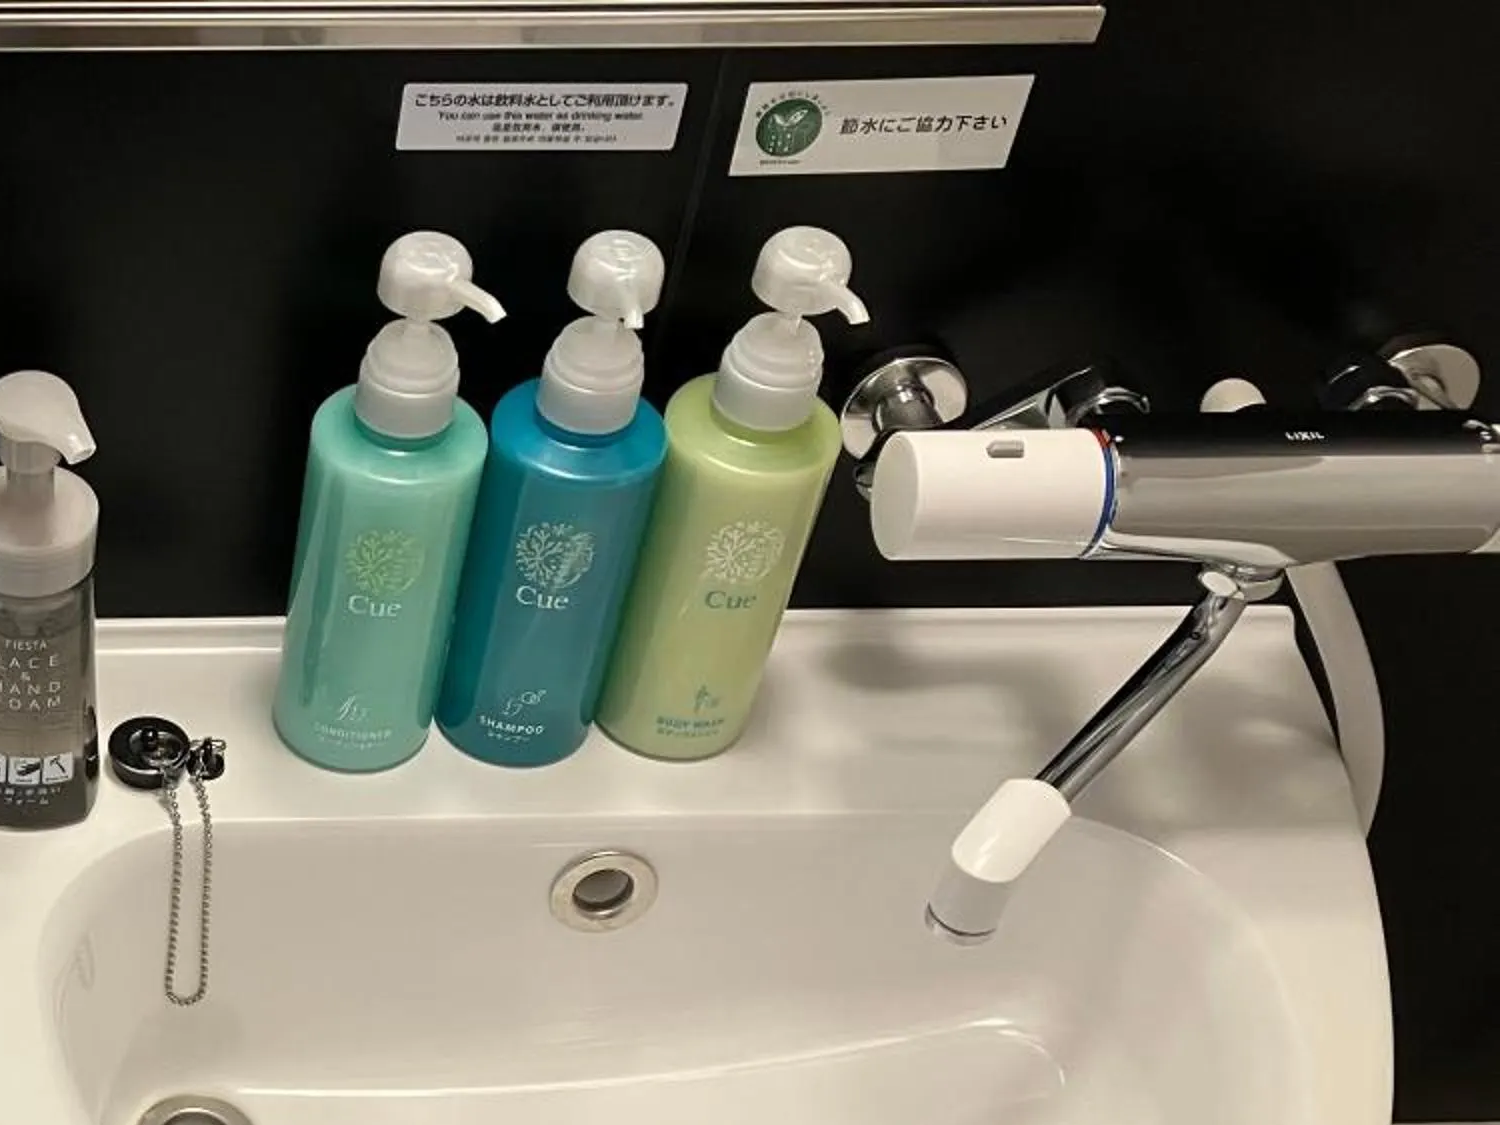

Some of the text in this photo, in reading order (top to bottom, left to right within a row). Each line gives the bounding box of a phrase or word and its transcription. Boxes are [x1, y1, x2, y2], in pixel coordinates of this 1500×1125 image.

[438, 112, 458, 120] You
[461, 112, 480, 120] can
[525, 112, 552, 120] water
[839, 115, 1007, 135] 節水にご協力下さい
[349, 595, 402, 617] Cue
[515, 585, 569, 609] Cue
[705, 590, 757, 609] Cue
[5, 639, 48, 651] FIESTA
[480, 714, 545, 736] SHAMPOO
